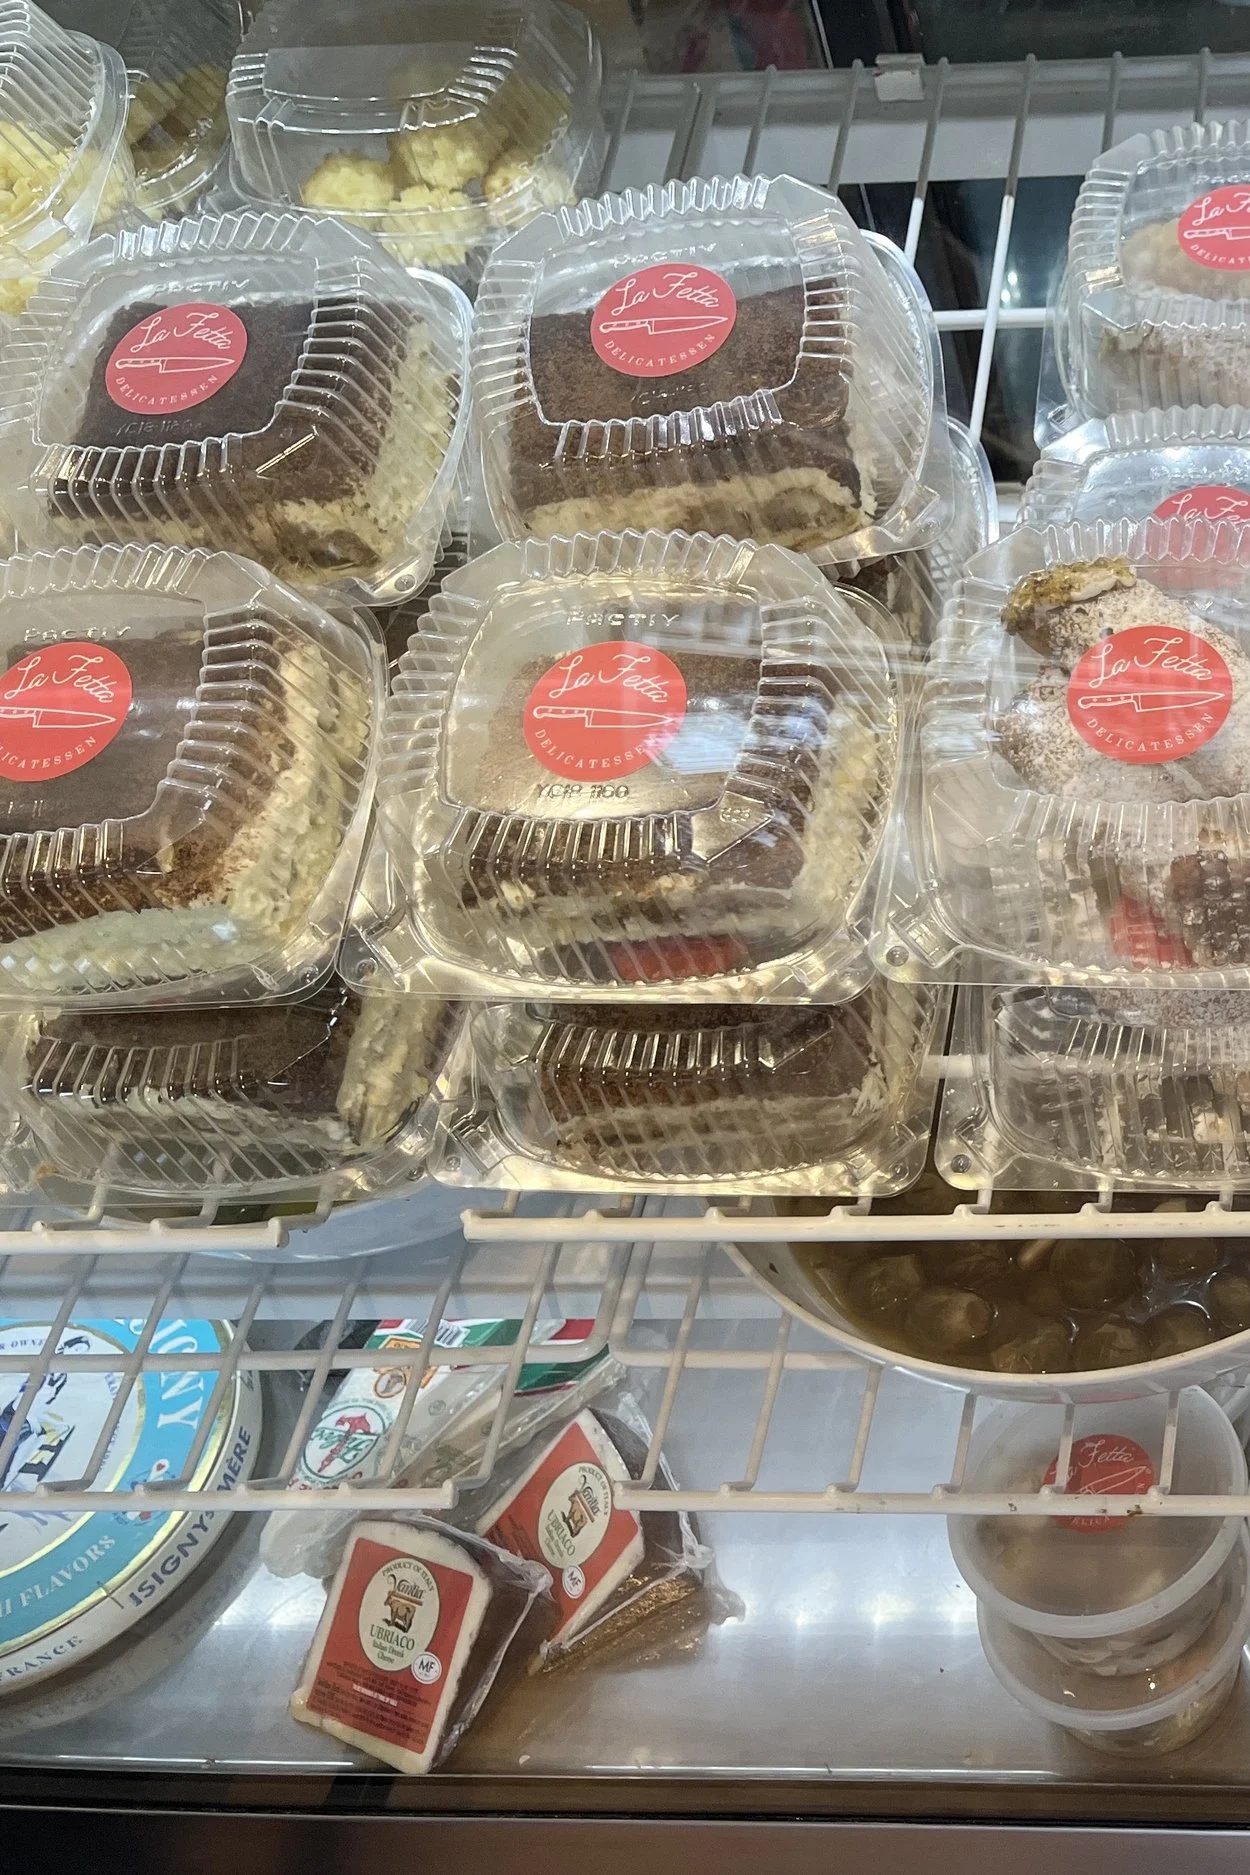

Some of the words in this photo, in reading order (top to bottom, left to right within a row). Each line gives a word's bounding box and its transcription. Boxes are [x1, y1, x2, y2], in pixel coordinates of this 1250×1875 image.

[1192, 196, 1225, 227] La
[611, 278, 650, 316] La
[653, 272, 720, 308] Fetta
[130, 316, 171, 353] La
[173, 312, 234, 350] Fetta
[605, 333, 716, 368] DELICATESSEN
[115, 374, 219, 406] DELICATESSEN
[4, 656, 49, 700] La
[52, 654, 118, 703] Fetta
[549, 655, 595, 699] La
[598, 653, 670, 703] Fetta
[1088, 643, 1131, 688] La
[1133, 636, 1213, 681] Fetta
[0, 735, 97, 769] ICATESSEN
[1086, 712, 1214, 752] DELICATESSEN
[1078, 1439, 1134, 1468] Fetta
[19, 1535, 116, 1608] FLAVORS
[128, 1512, 211, 1607] ISIGNY
[370, 1624, 415, 1651] UBRIACO
[0, 1635, 83, 1682] RANCE
[418, 1658, 436, 1673] MF
